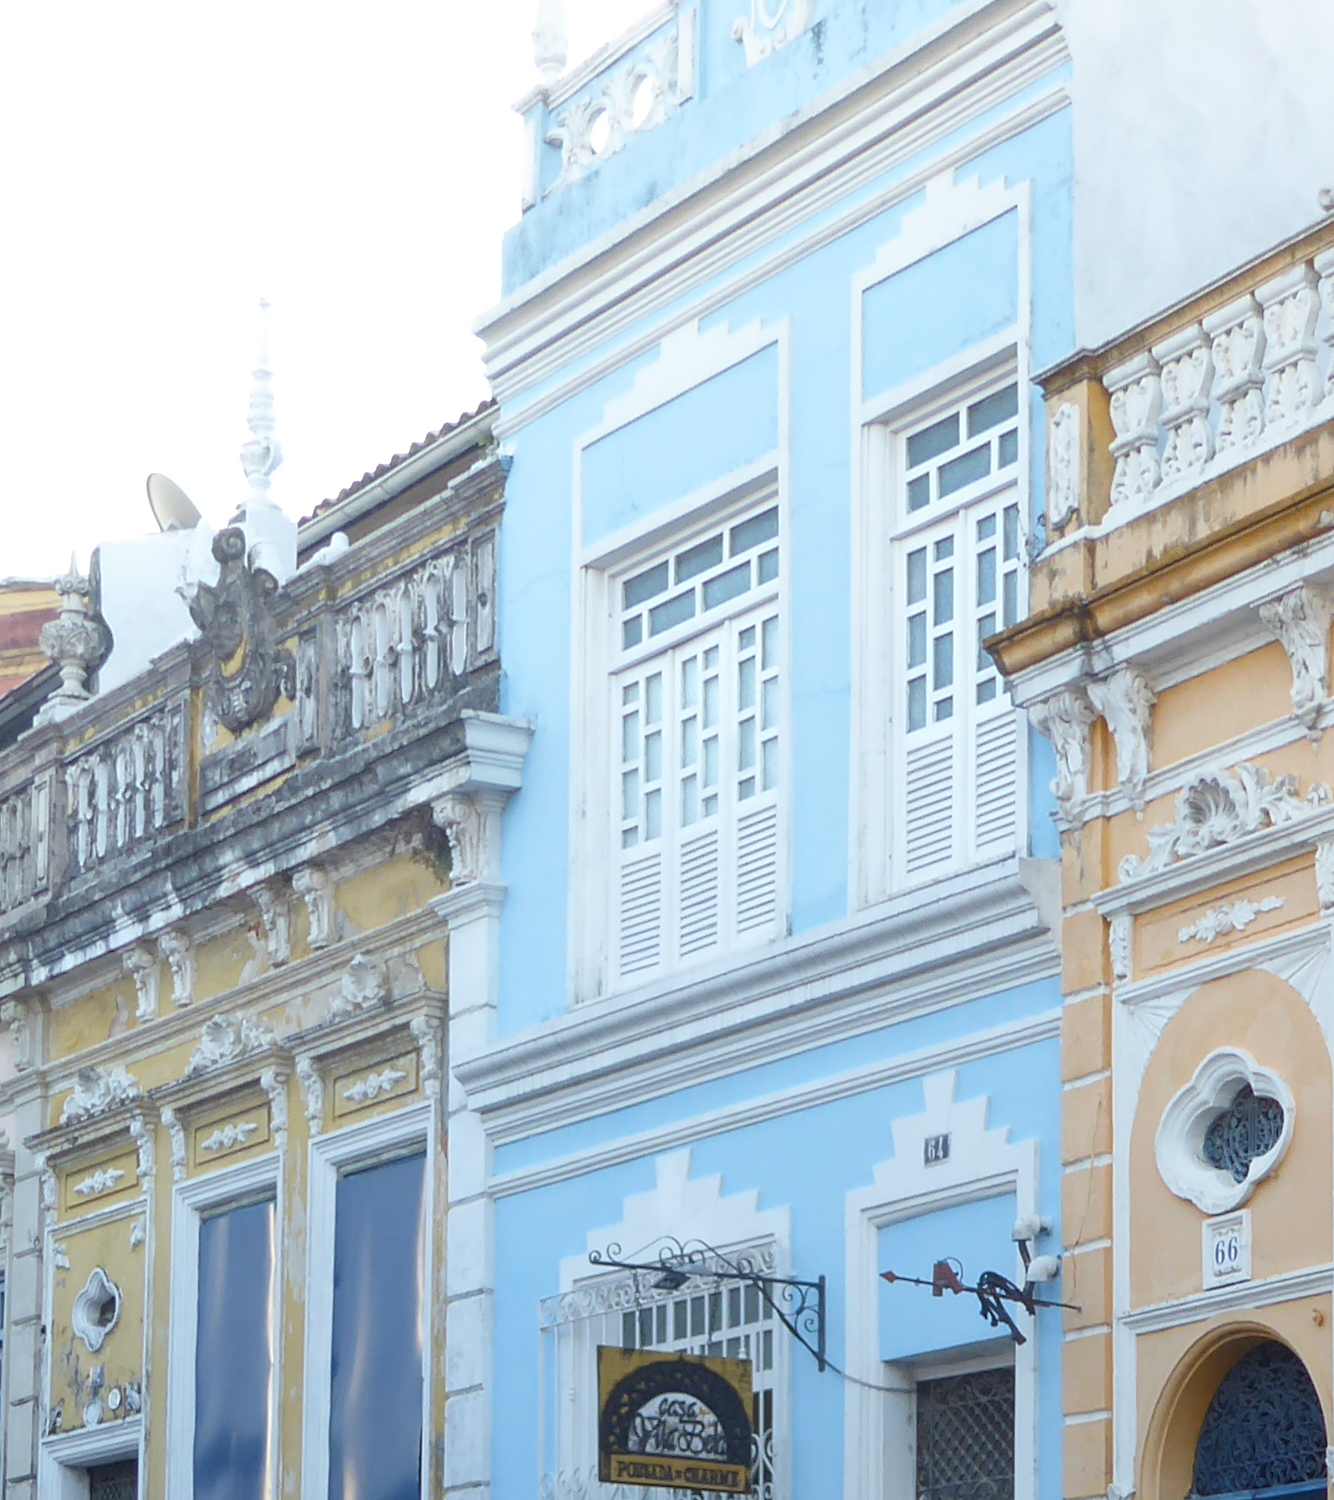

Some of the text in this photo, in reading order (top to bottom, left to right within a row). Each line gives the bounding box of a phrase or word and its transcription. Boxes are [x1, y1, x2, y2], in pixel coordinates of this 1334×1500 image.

[928, 1136, 944, 1161] 64
[1214, 1236, 1238, 1265] 66
[616, 1461, 675, 1482] POUSADA
[683, 1465, 741, 1488] CHARME
